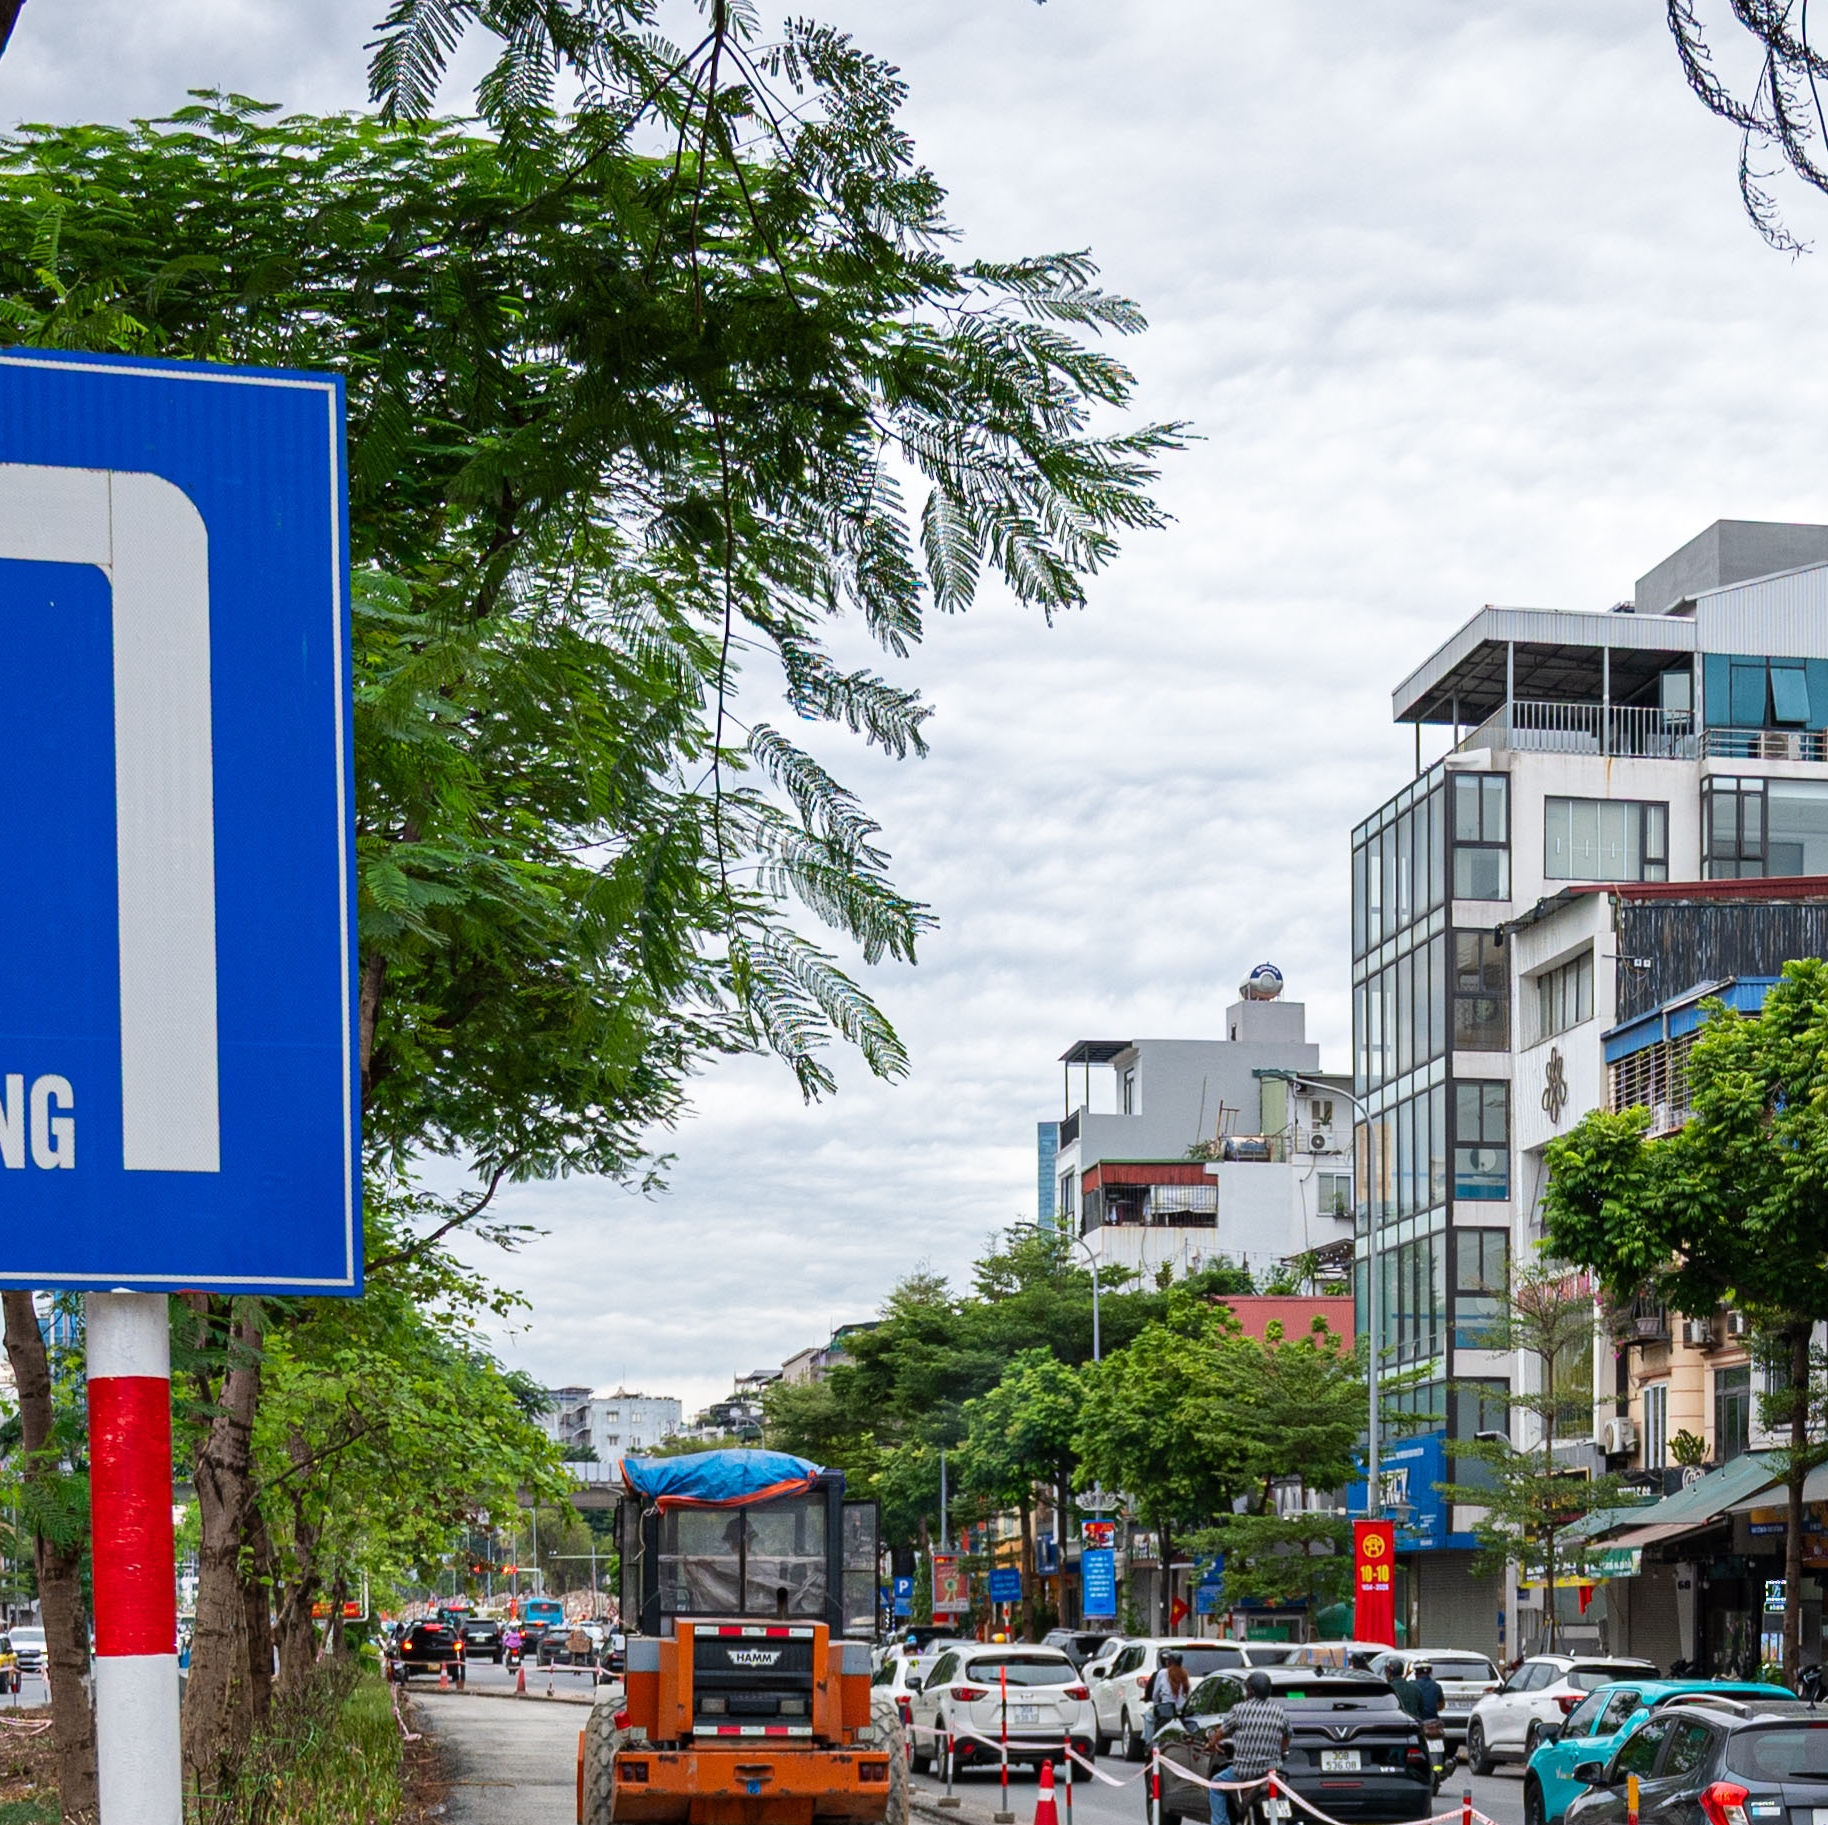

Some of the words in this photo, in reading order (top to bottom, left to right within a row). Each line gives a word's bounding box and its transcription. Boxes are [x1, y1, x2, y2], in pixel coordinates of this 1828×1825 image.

[1360, 1564, 1390, 1583] 10-10
[898, 1580, 910, 1594] P
[736, 1653, 772, 1662] HAMM
